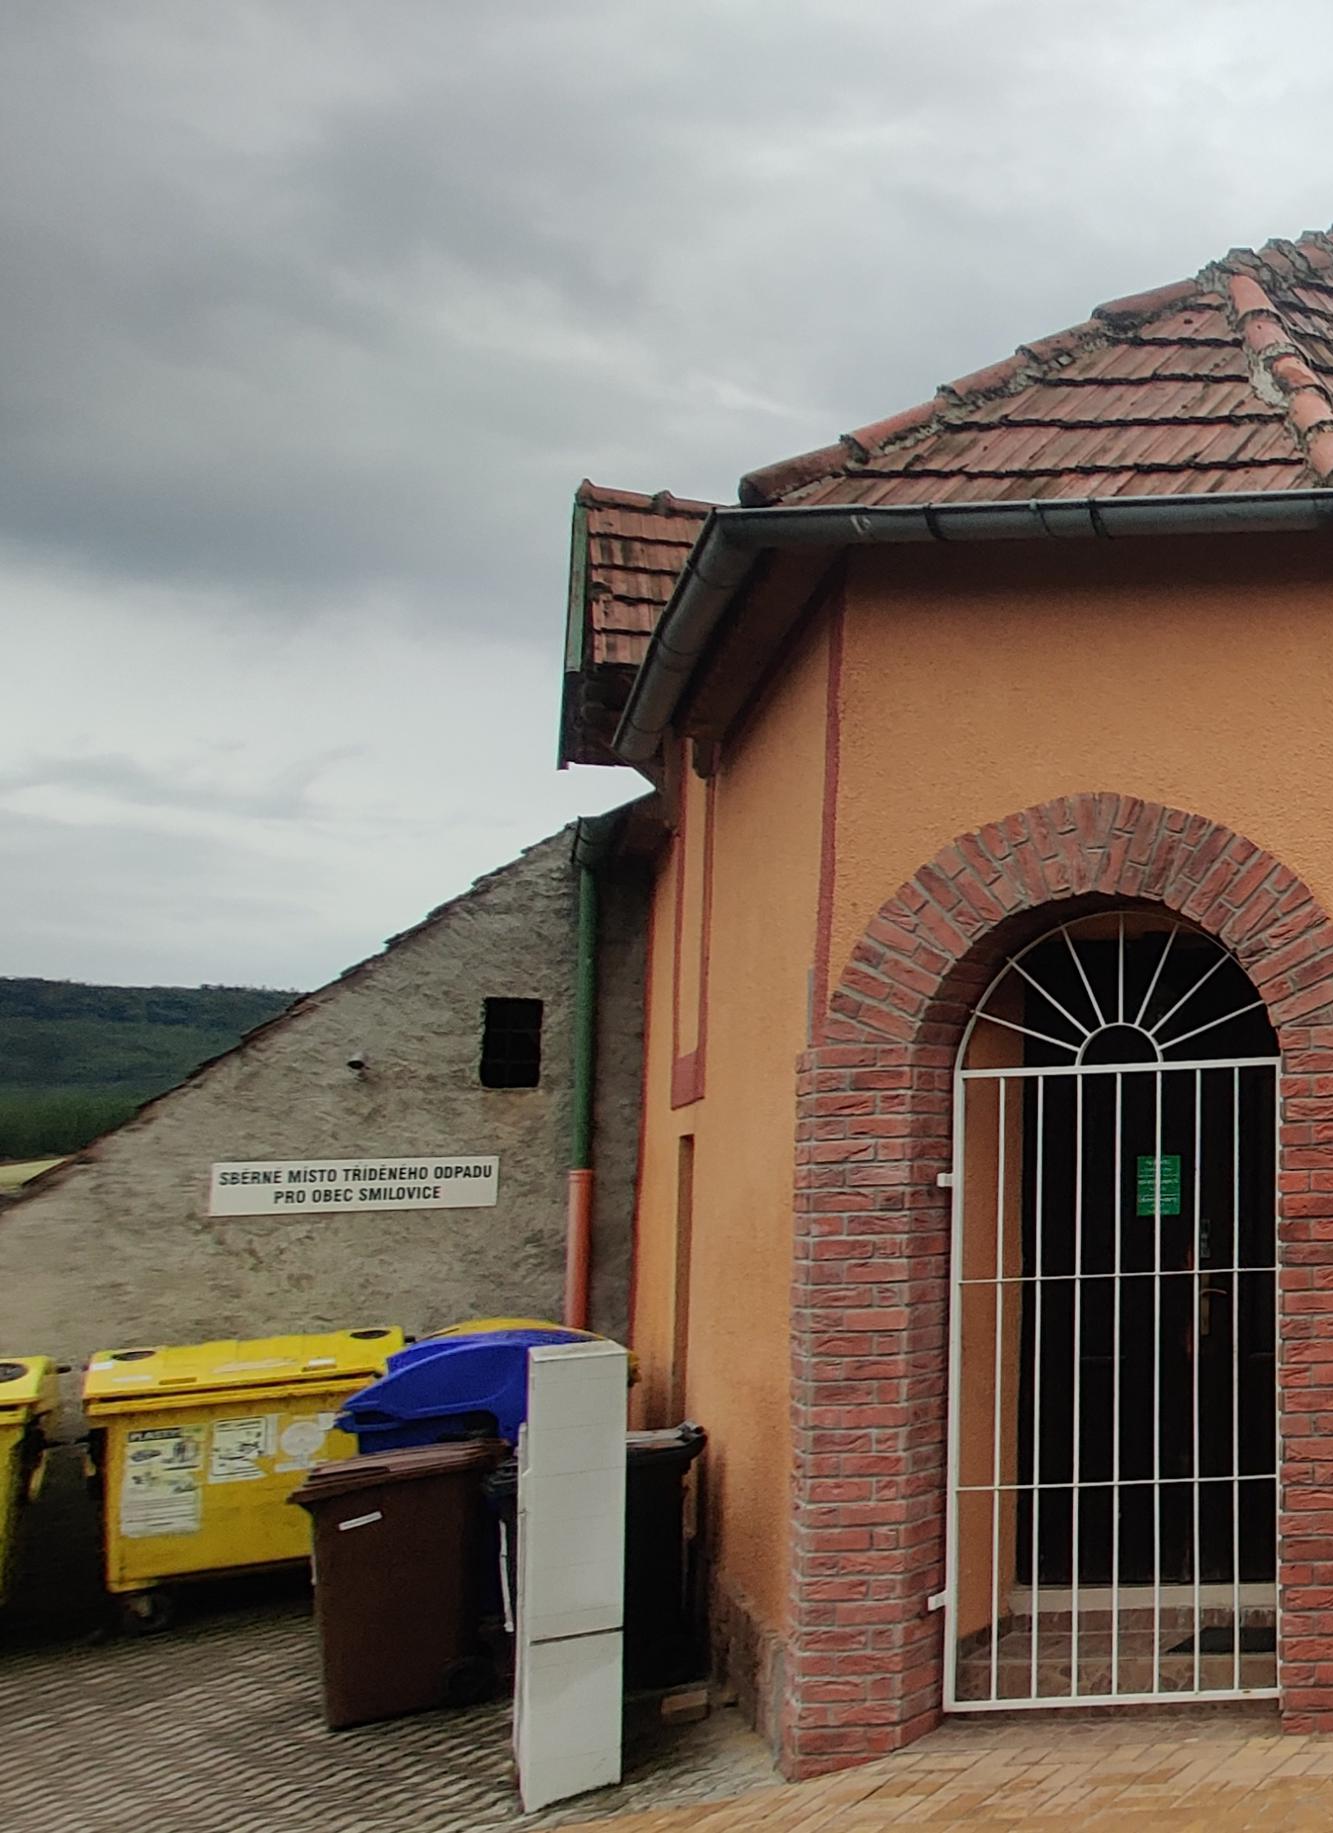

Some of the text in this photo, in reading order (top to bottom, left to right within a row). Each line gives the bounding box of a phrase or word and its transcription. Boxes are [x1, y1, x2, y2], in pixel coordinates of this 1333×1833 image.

[218, 1164, 493, 1186] SBĚRNÉ MÍSTO TŘÍDĚNÉHO ODPADU
[273, 1186, 442, 1204] PRO OBEC SMILOVICE
